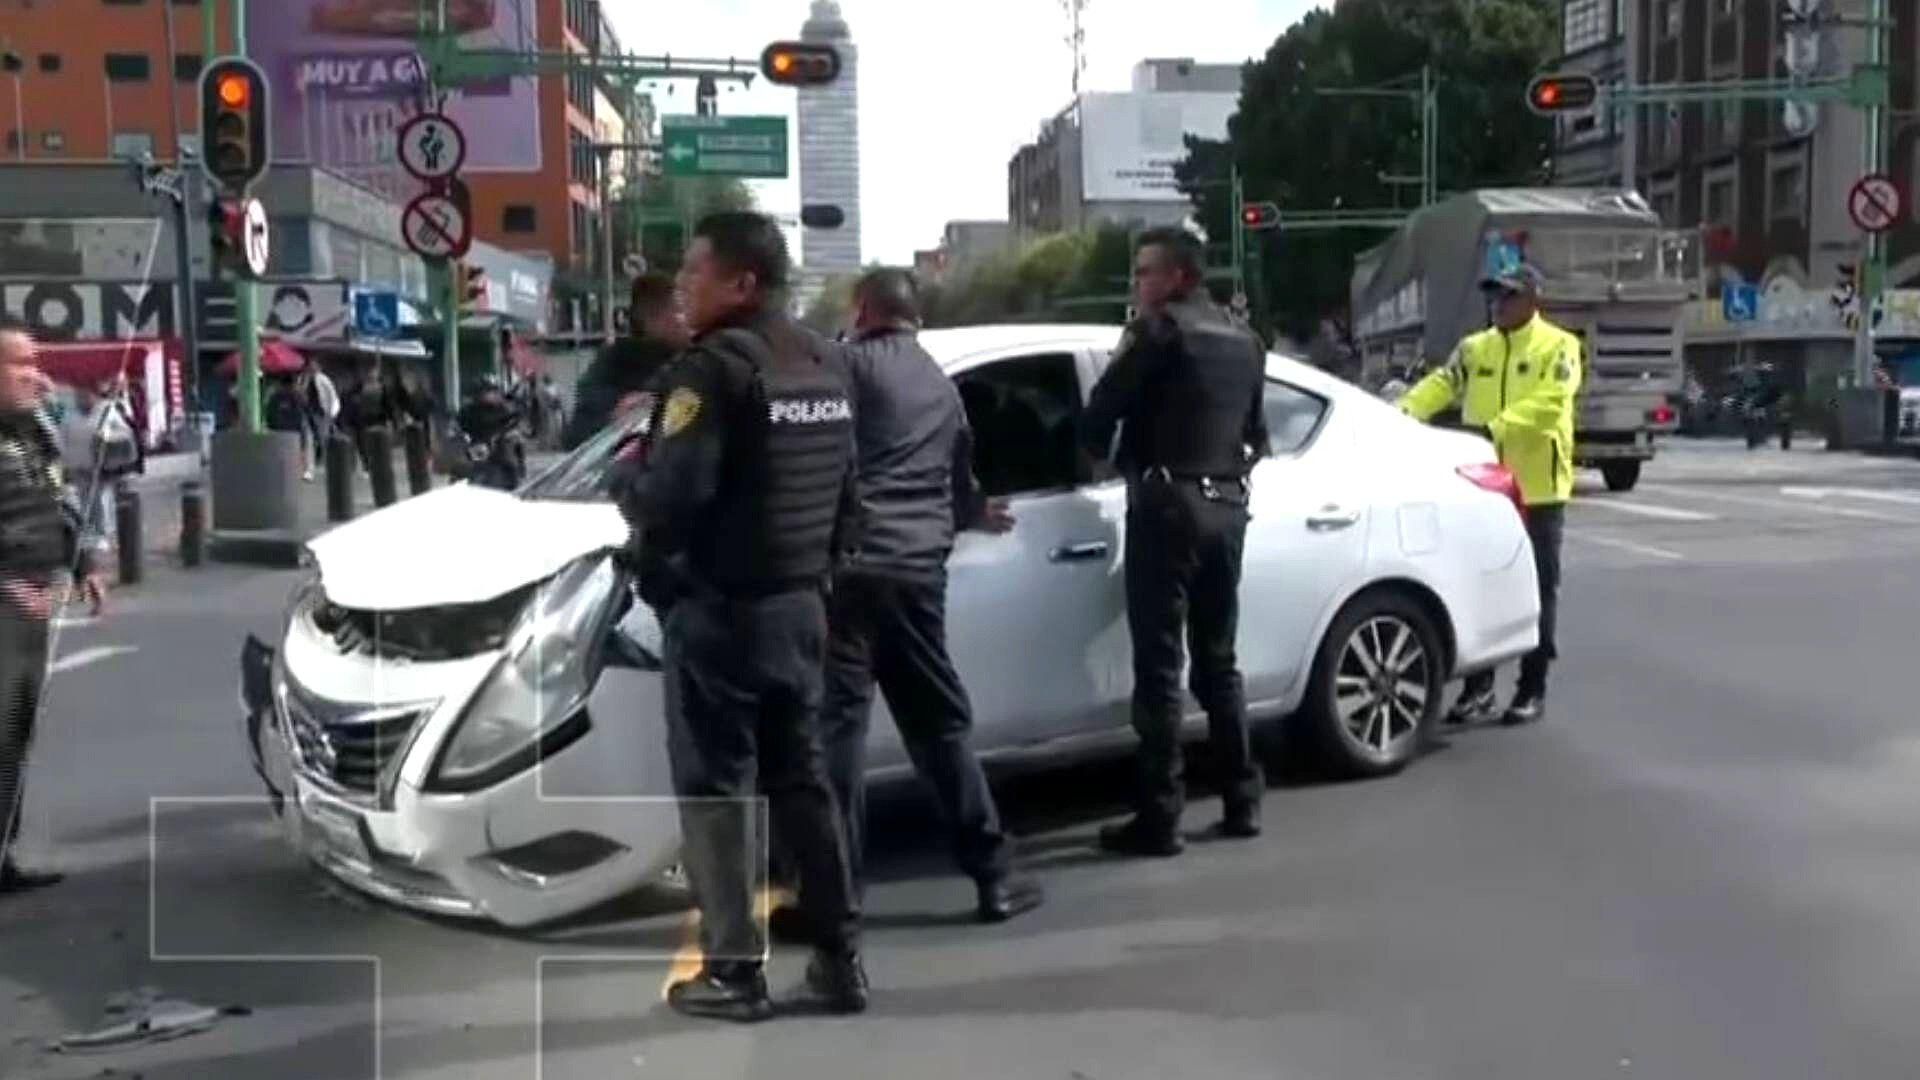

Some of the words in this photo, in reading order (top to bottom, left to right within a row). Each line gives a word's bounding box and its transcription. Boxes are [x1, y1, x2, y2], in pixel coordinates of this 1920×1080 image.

[303, 60, 364, 85] MUY
[368, 58, 389, 83] A
[768, 399, 851, 423] POLICIA
